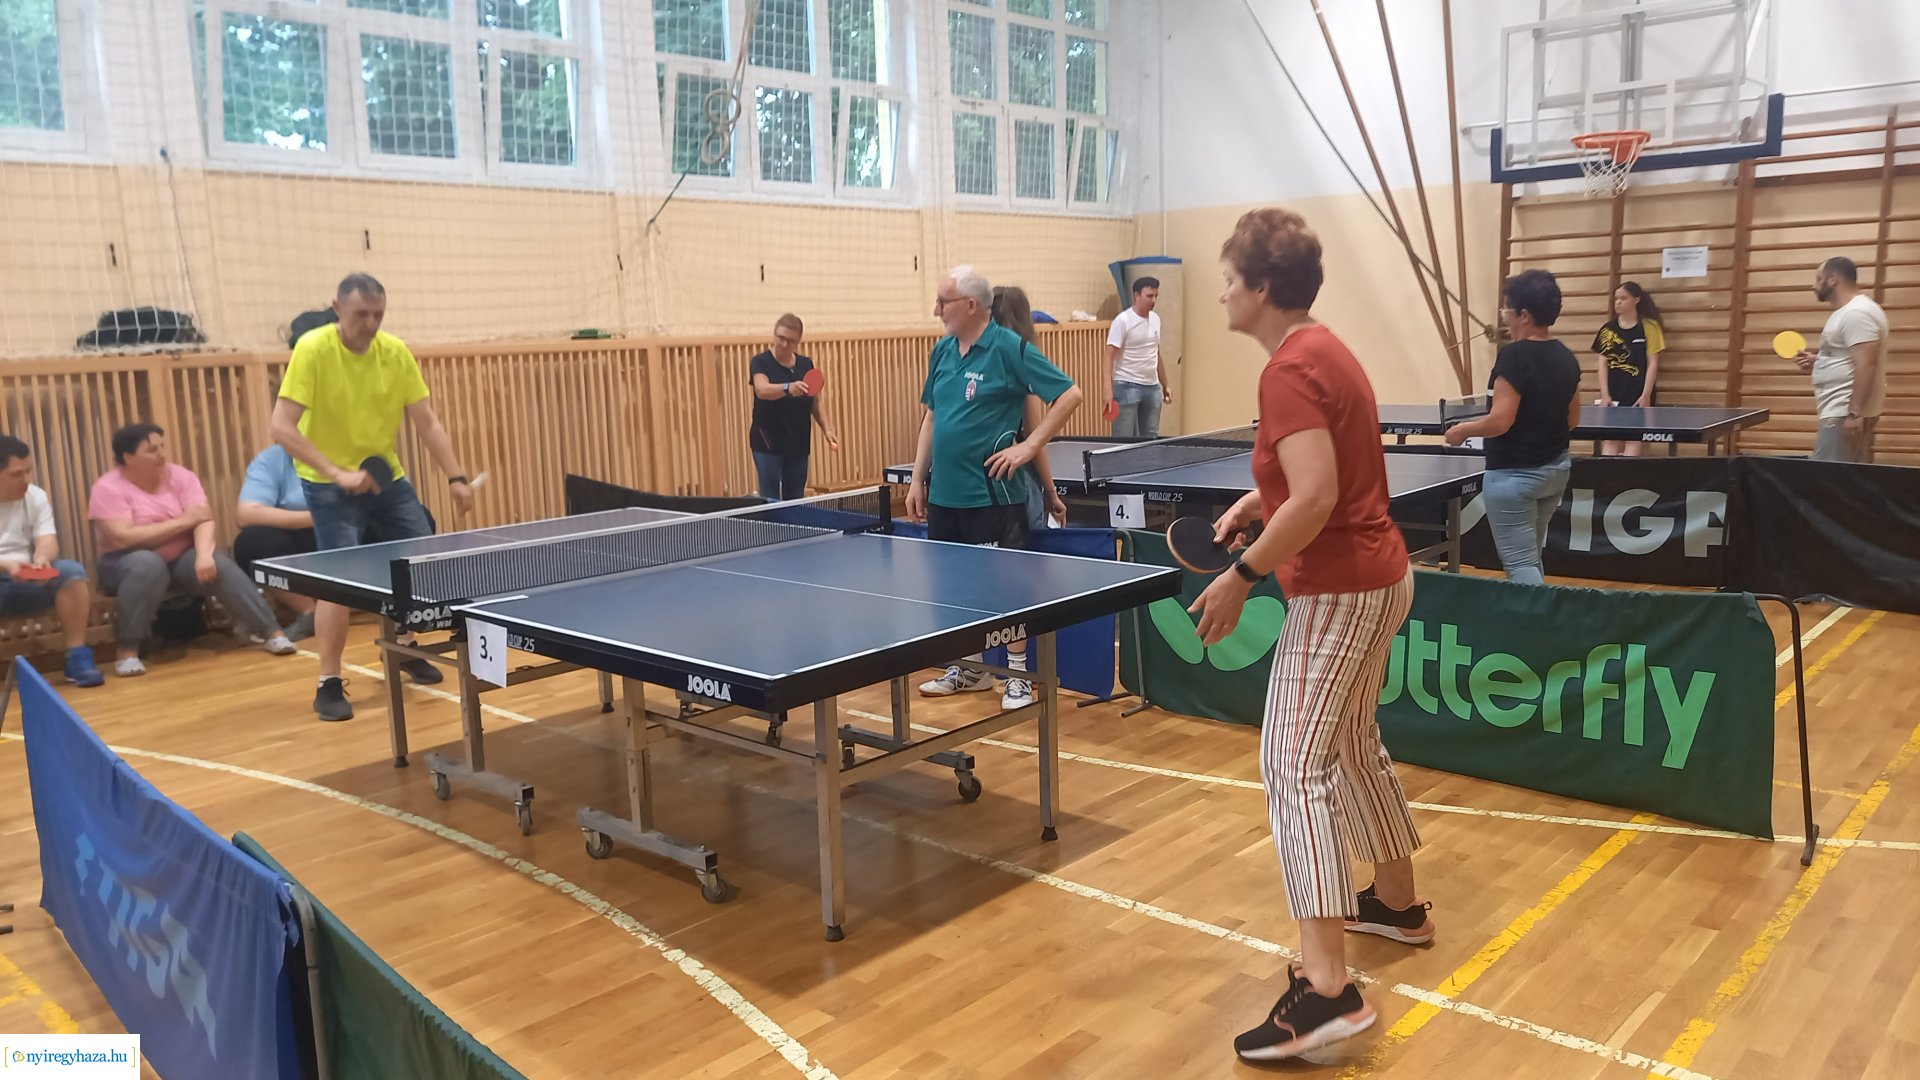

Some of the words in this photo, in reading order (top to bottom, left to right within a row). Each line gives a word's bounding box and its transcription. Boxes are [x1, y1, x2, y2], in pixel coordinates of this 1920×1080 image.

[1642, 432, 1674, 442] JOOLA
[1172, 492, 1184, 502] 25
[1115, 504, 1130, 520] 4.
[523, 637, 535, 652] 25
[985, 623, 1027, 650] JOOLA
[479, 635, 493, 662] 3.
[687, 673, 732, 702] JOOLA
[1378, 619, 1716, 769] utterfly
